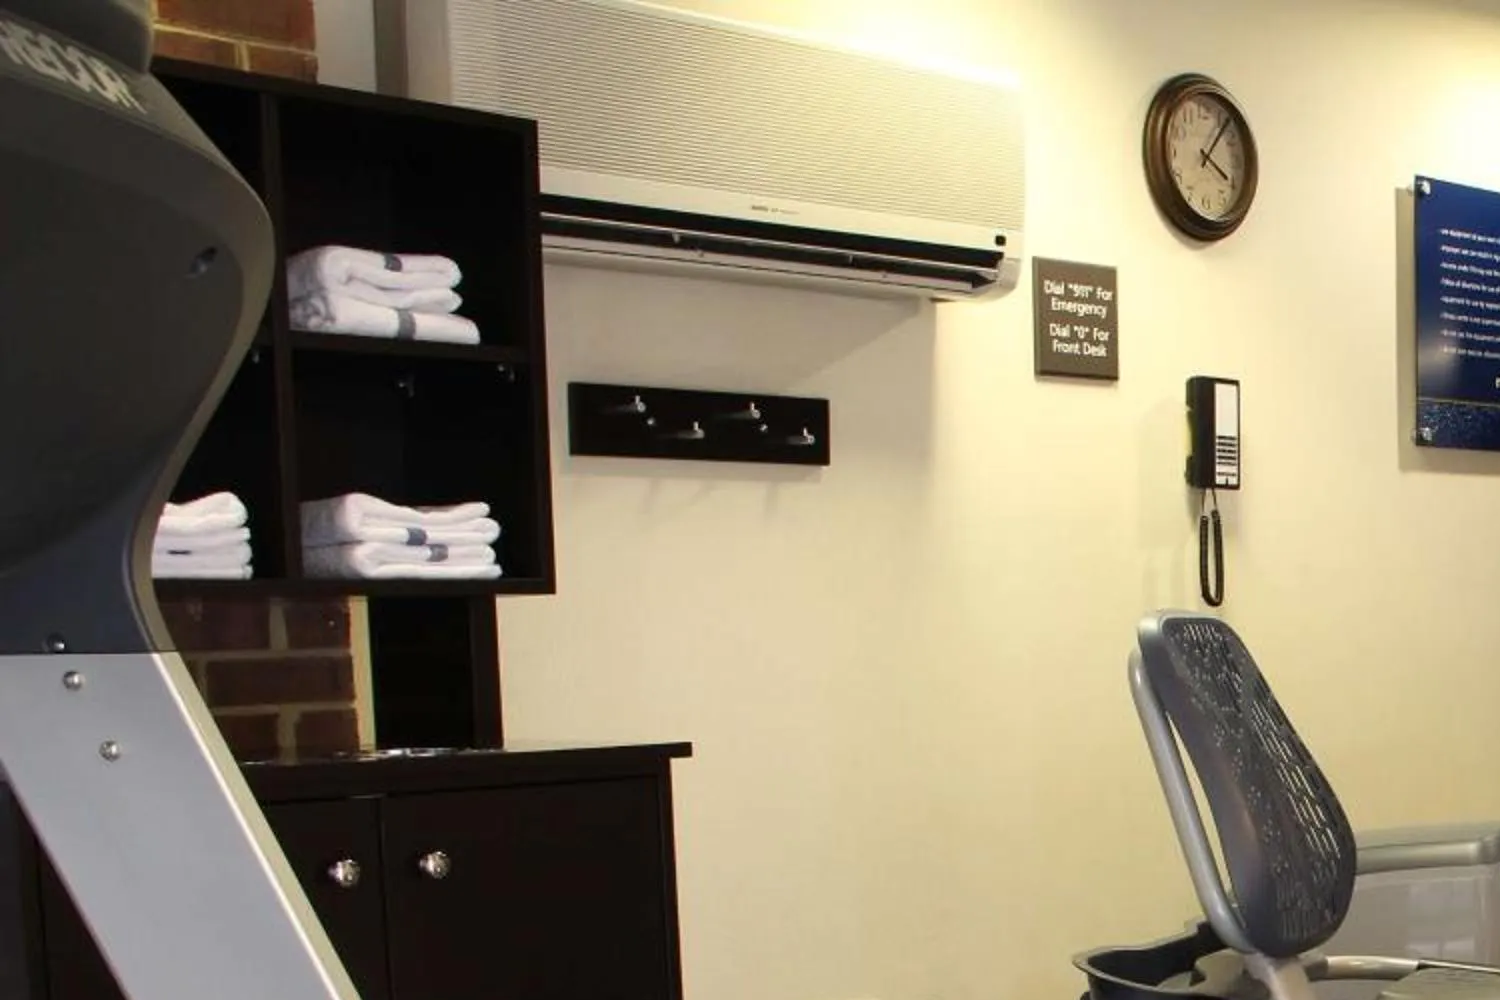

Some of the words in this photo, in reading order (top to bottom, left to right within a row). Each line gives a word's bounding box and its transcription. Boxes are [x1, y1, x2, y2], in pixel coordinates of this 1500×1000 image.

[0, 20, 147, 115] RECOR
[1043, 279, 1065, 296] Dial
[1051, 296, 1108, 320] Emergency
[1049, 323, 1071, 338] Dial
[1053, 339, 1081, 356] Front
[1083, 341, 1108, 358] Desk
